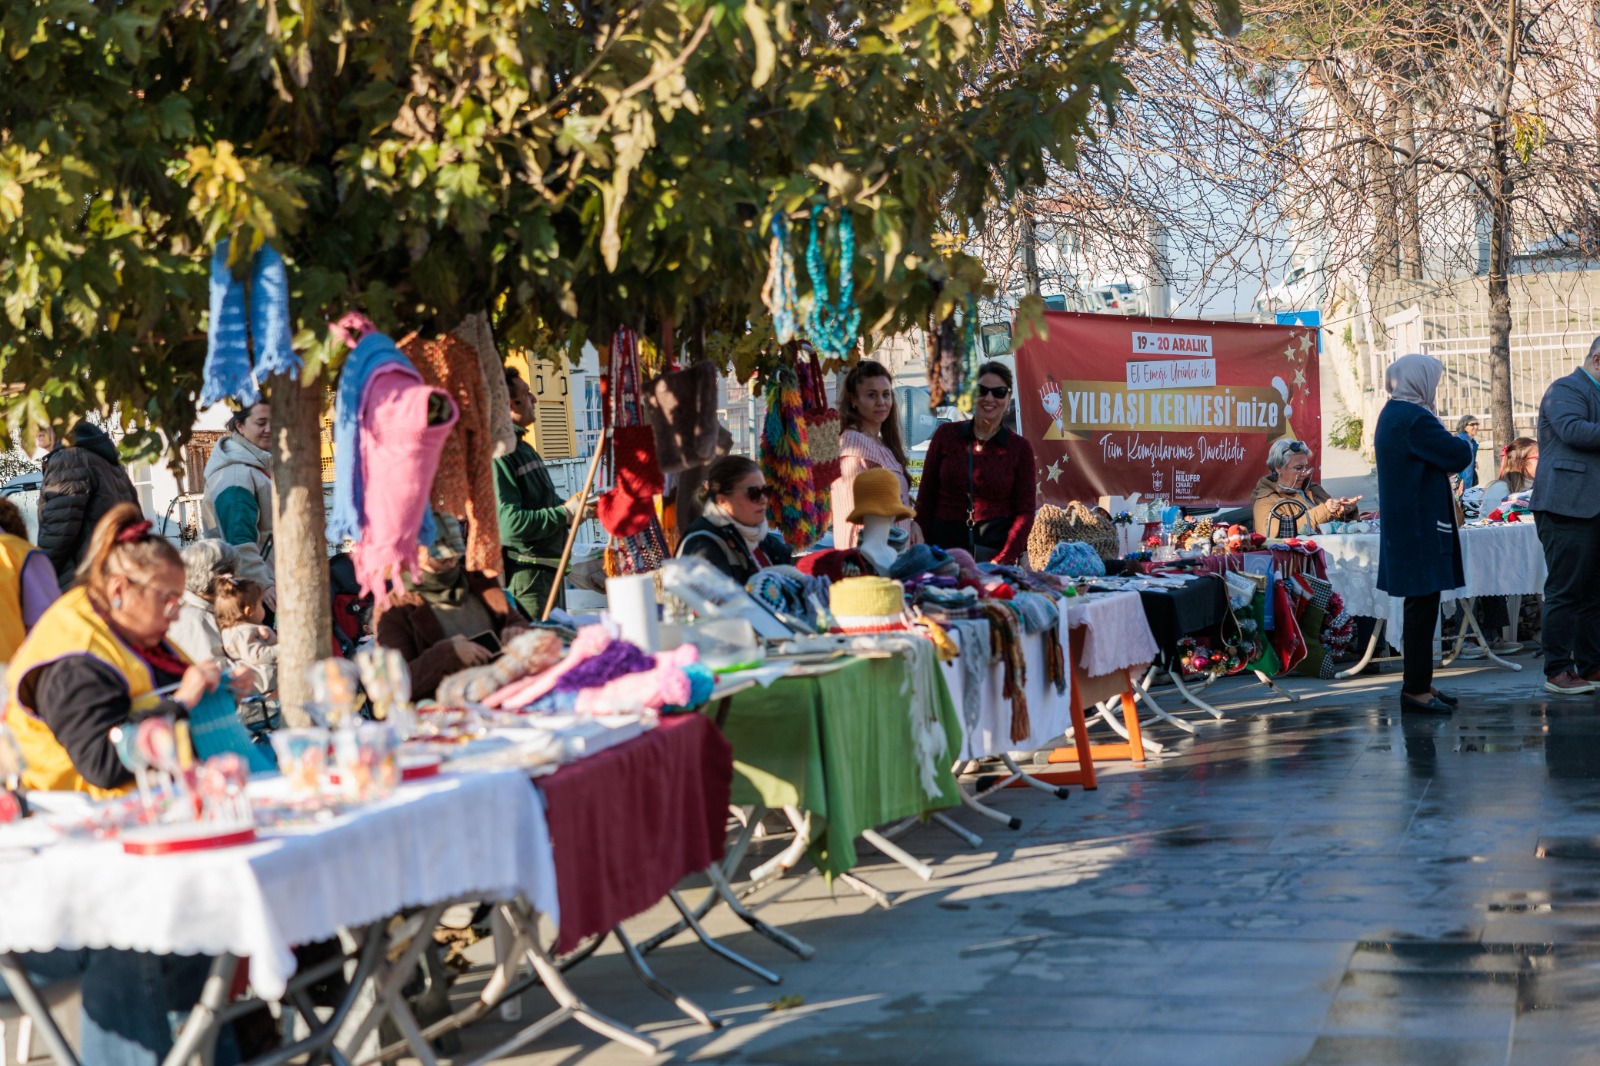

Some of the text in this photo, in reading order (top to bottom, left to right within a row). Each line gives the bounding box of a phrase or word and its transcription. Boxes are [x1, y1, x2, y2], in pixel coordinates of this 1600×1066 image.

[1137, 335, 1147, 350] 19
[1157, 337, 1170, 351] 20
[1172, 338, 1208, 352] ARALIK
[1130, 364, 1140, 384] El
[1143, 364, 1168, 388] Emeği
[1201, 361, 1212, 380] ile
[1067, 391, 1145, 430] YILBAŞI
[1099, 432, 1123, 463] Tüm
[1197, 435, 1247, 466] Davetlidir
